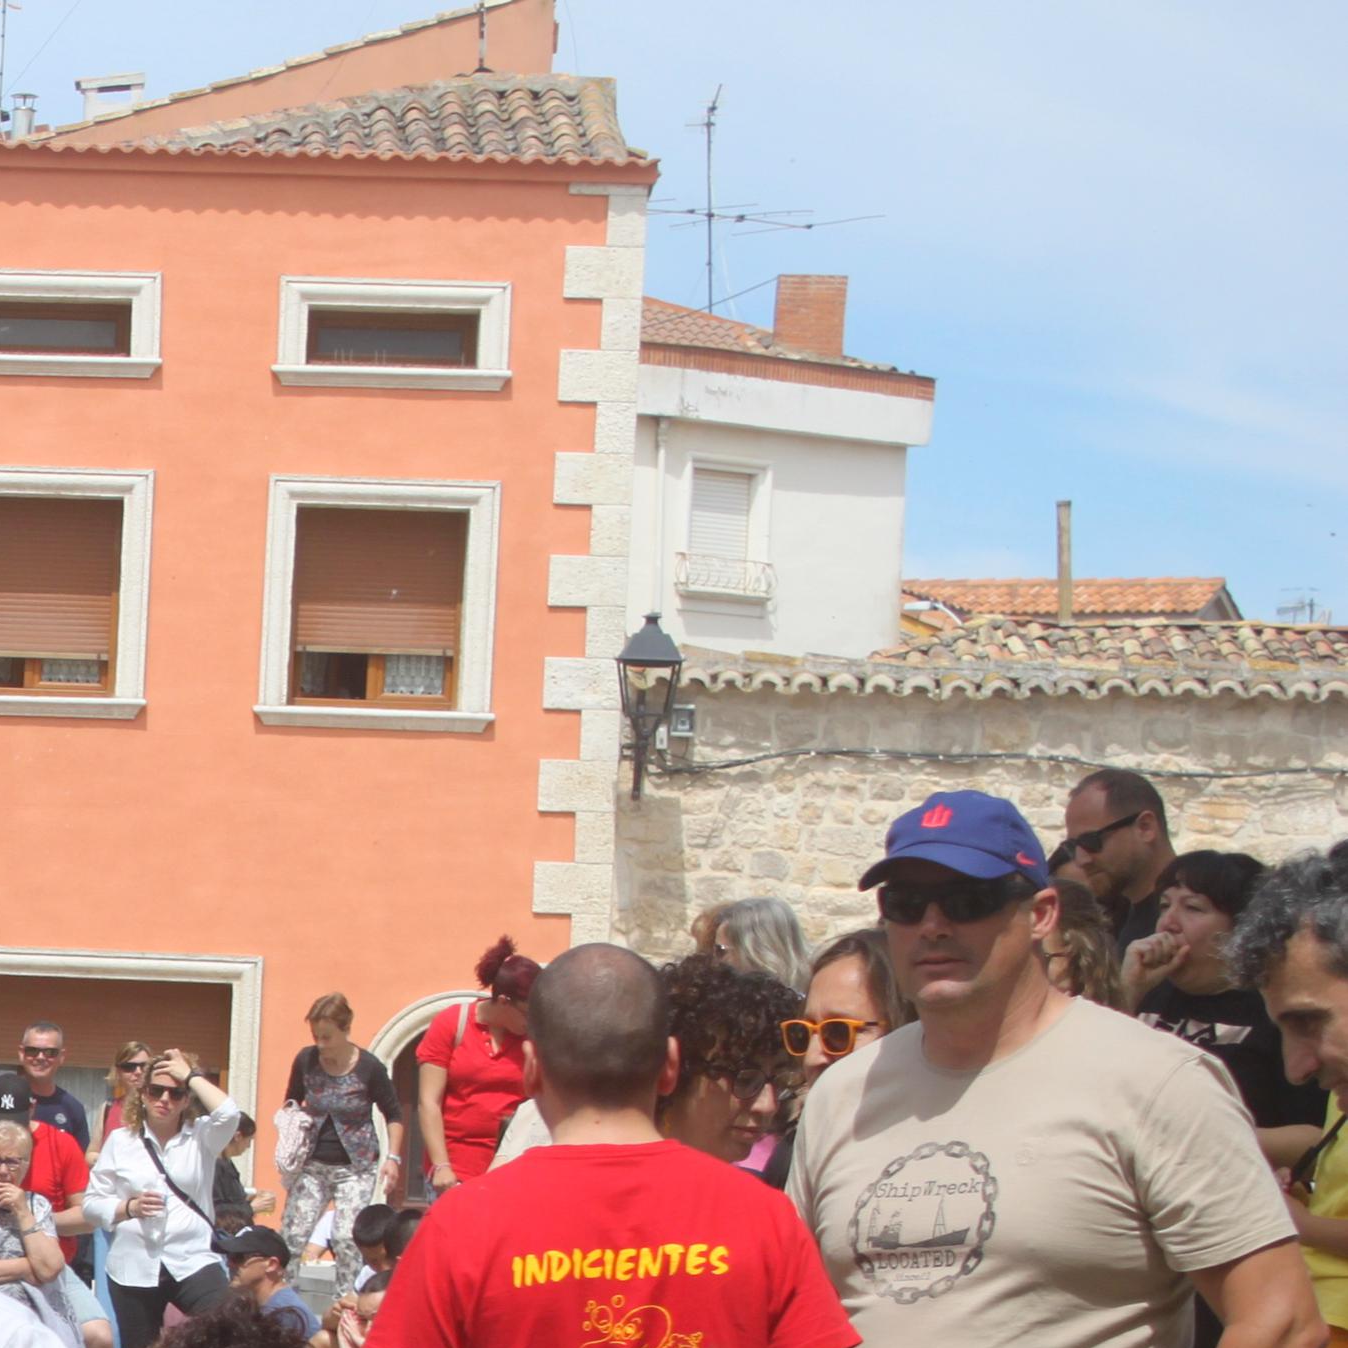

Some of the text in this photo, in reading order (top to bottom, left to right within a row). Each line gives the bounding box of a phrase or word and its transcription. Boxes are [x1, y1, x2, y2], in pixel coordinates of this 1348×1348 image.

[874, 1177, 981, 1202] ShipWreck
[512, 1243, 729, 1288] INDICIENTES
[875, 1250, 956, 1270] LOCATED
